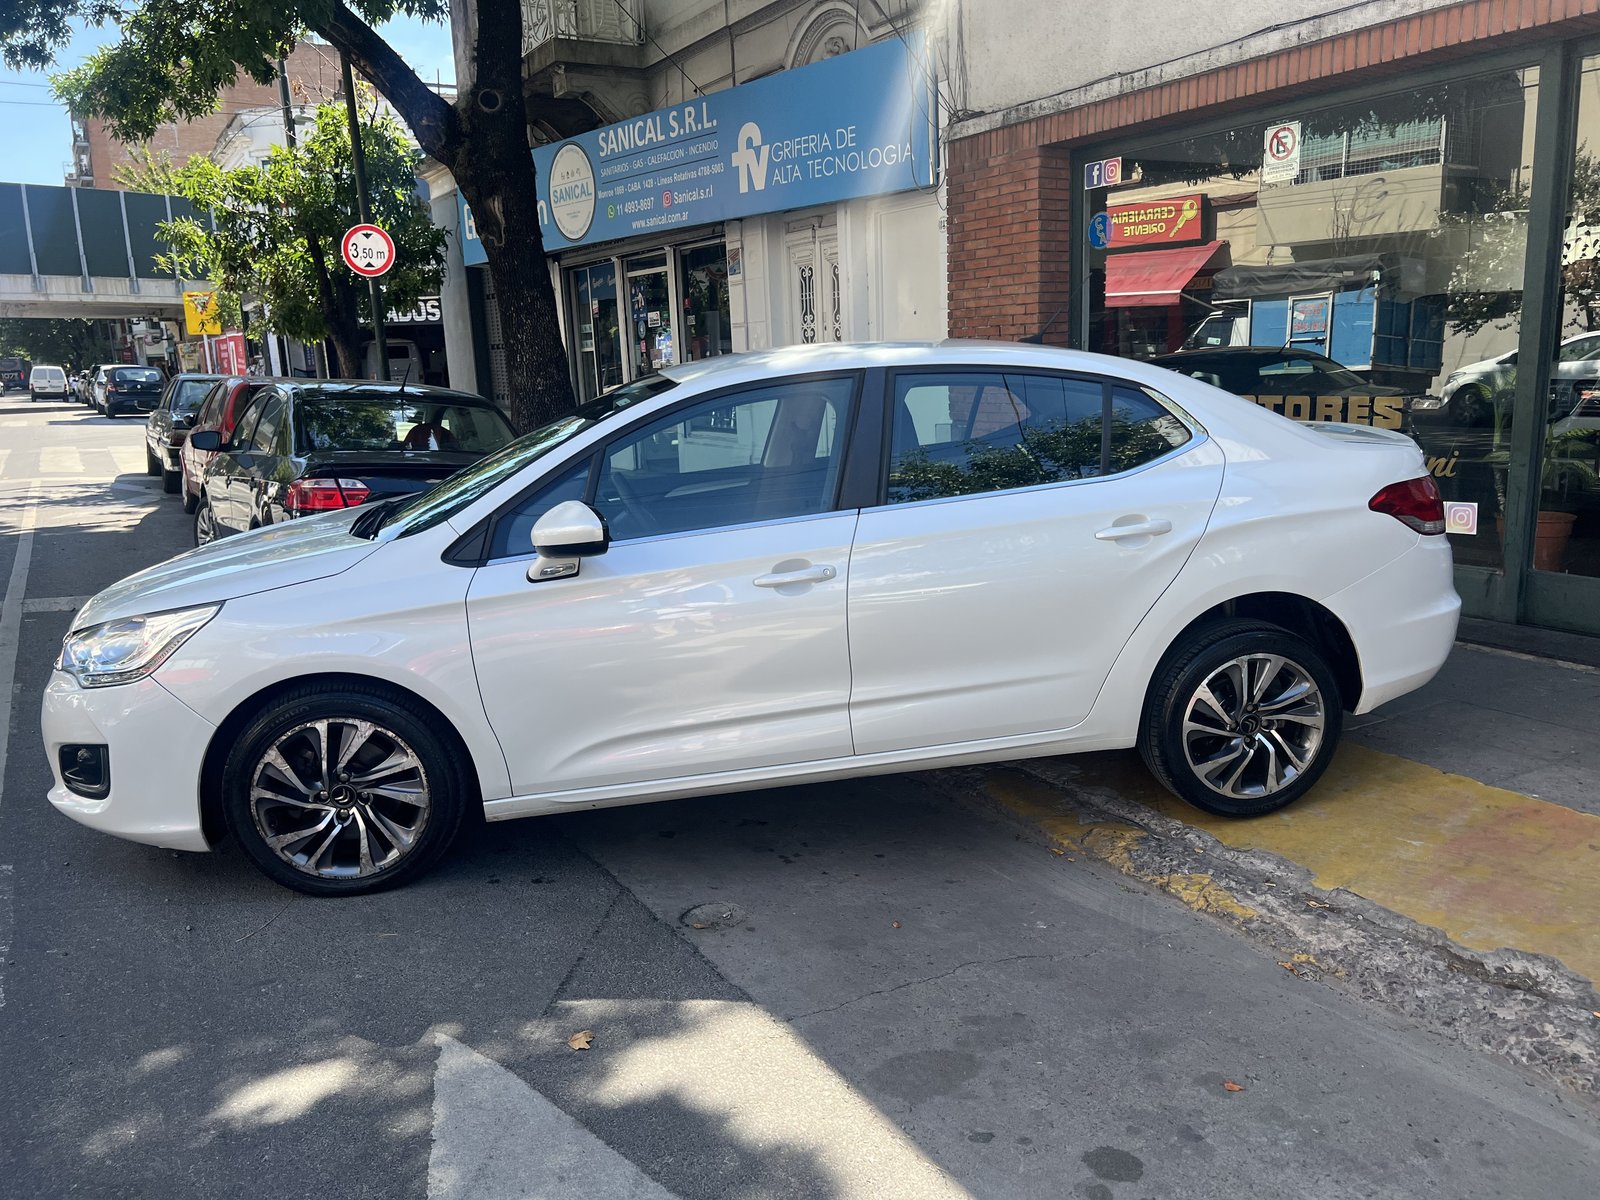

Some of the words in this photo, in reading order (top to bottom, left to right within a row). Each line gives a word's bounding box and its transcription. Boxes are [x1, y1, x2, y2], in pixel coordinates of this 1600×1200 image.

[598, 115, 666, 157] SANICAL
[669, 101, 717, 138] S.R.L.
[632, 157, 644, 169] GAS
[688, 139, 719, 156] INCENDIO
[771, 132, 832, 163] GRIFERIA
[836, 125, 857, 149] DE
[771, 164, 803, 186] ALTA
[807, 142, 915, 180] TECNOLOGIA
[552, 181, 593, 204] SANICAL
[627, 181, 642, 193] CABA
[616, 203, 624, 216] 11
[631, 211, 689, 230] www.sanical.com.ar
[376, 250, 386, 260] m
